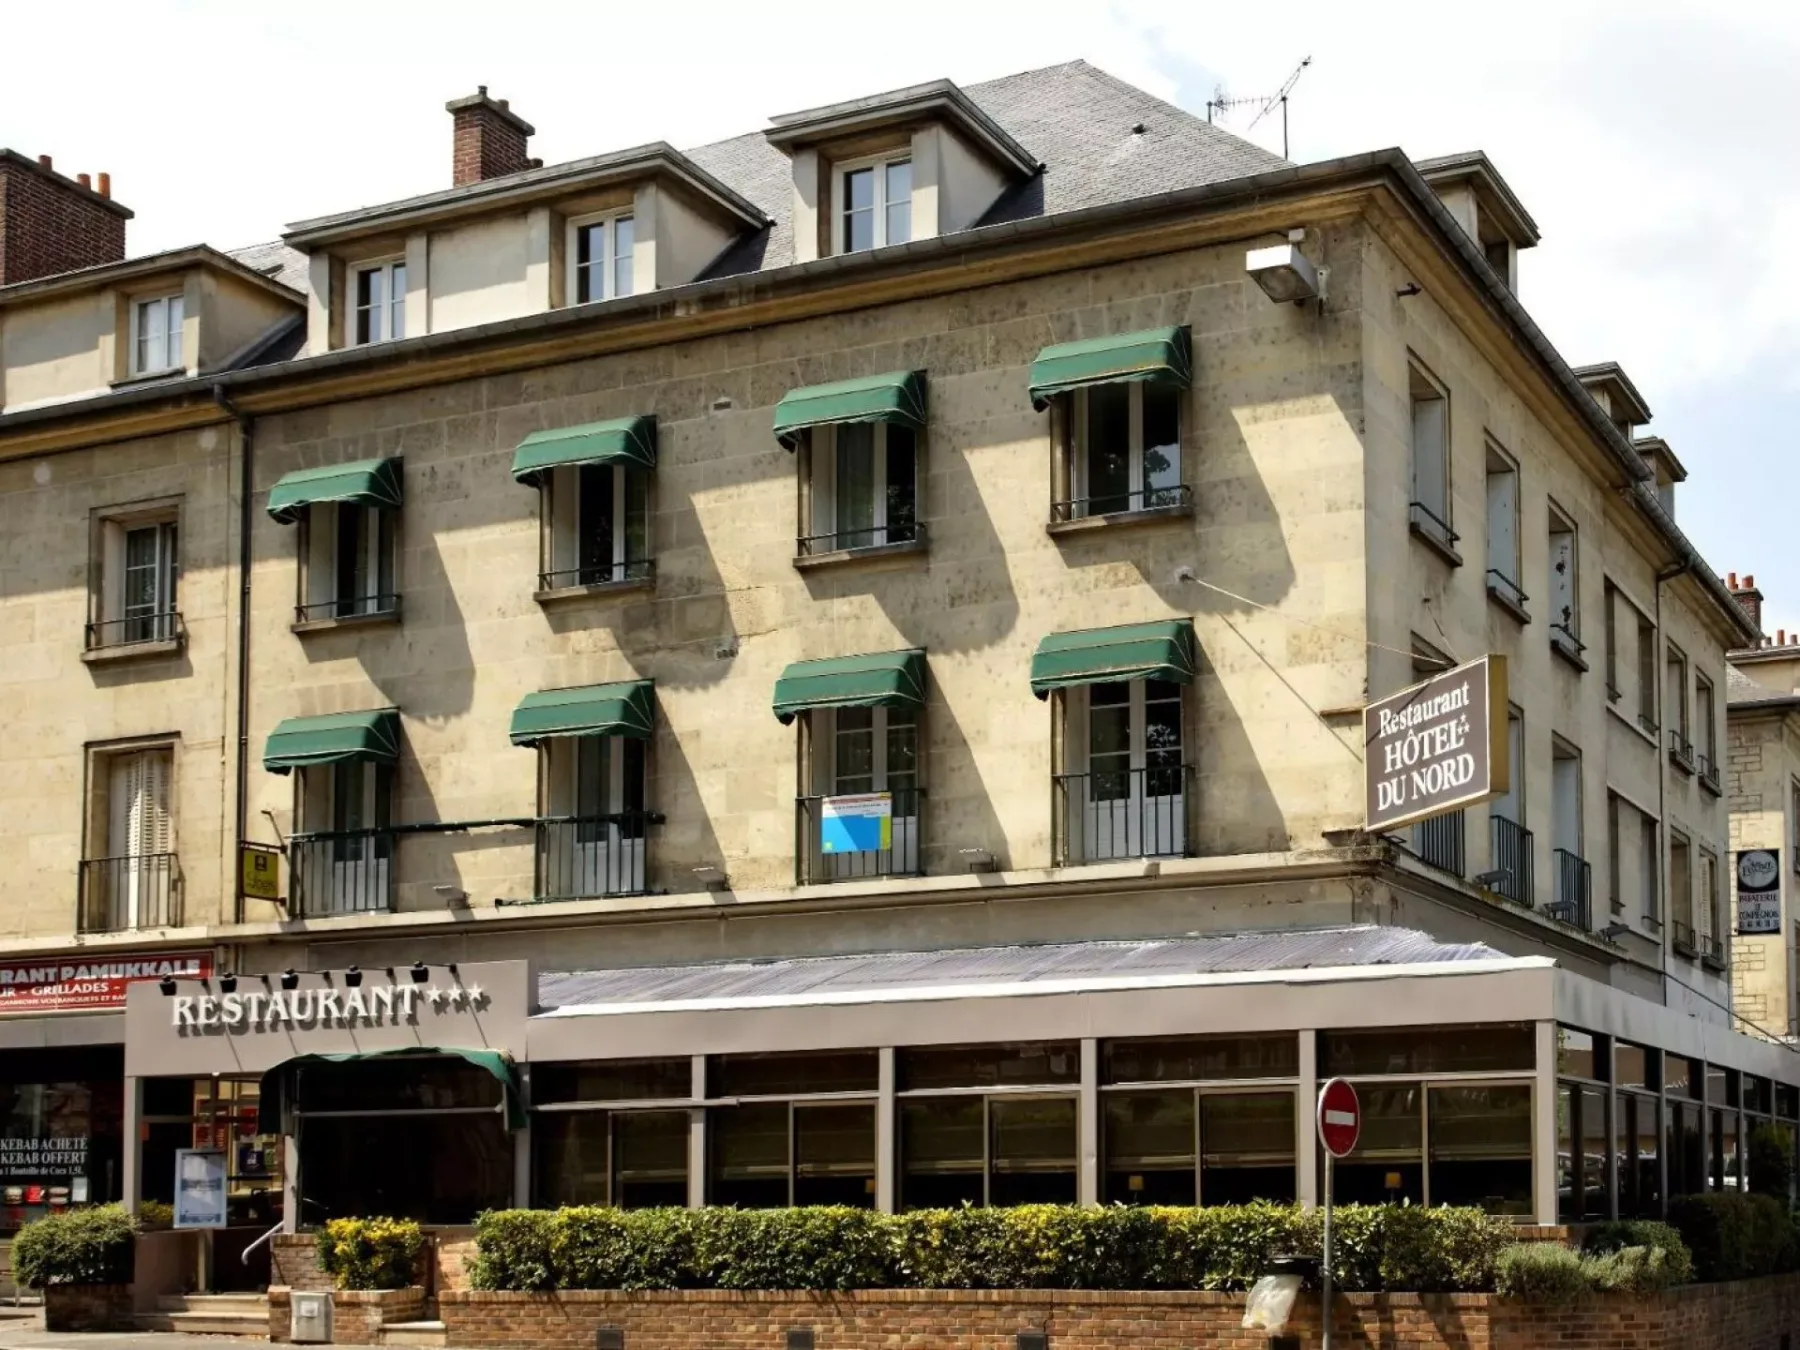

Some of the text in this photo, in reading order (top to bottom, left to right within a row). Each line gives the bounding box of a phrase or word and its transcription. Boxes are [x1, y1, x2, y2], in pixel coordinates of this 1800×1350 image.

[1379, 681, 1470, 738] Restaurant
[1384, 718, 1465, 774] HÔTEL
[1377, 753, 1475, 811] DU NORD
[61, 959, 200, 981] PAMUKKALE
[31, 982, 109, 997] GRILLADES
[172, 983, 418, 1026] RESTAURANT
[0, 1135, 88, 1150] KEBAB ACHETÉ
[0, 1151, 87, 1165] KEBAB OFFERT
